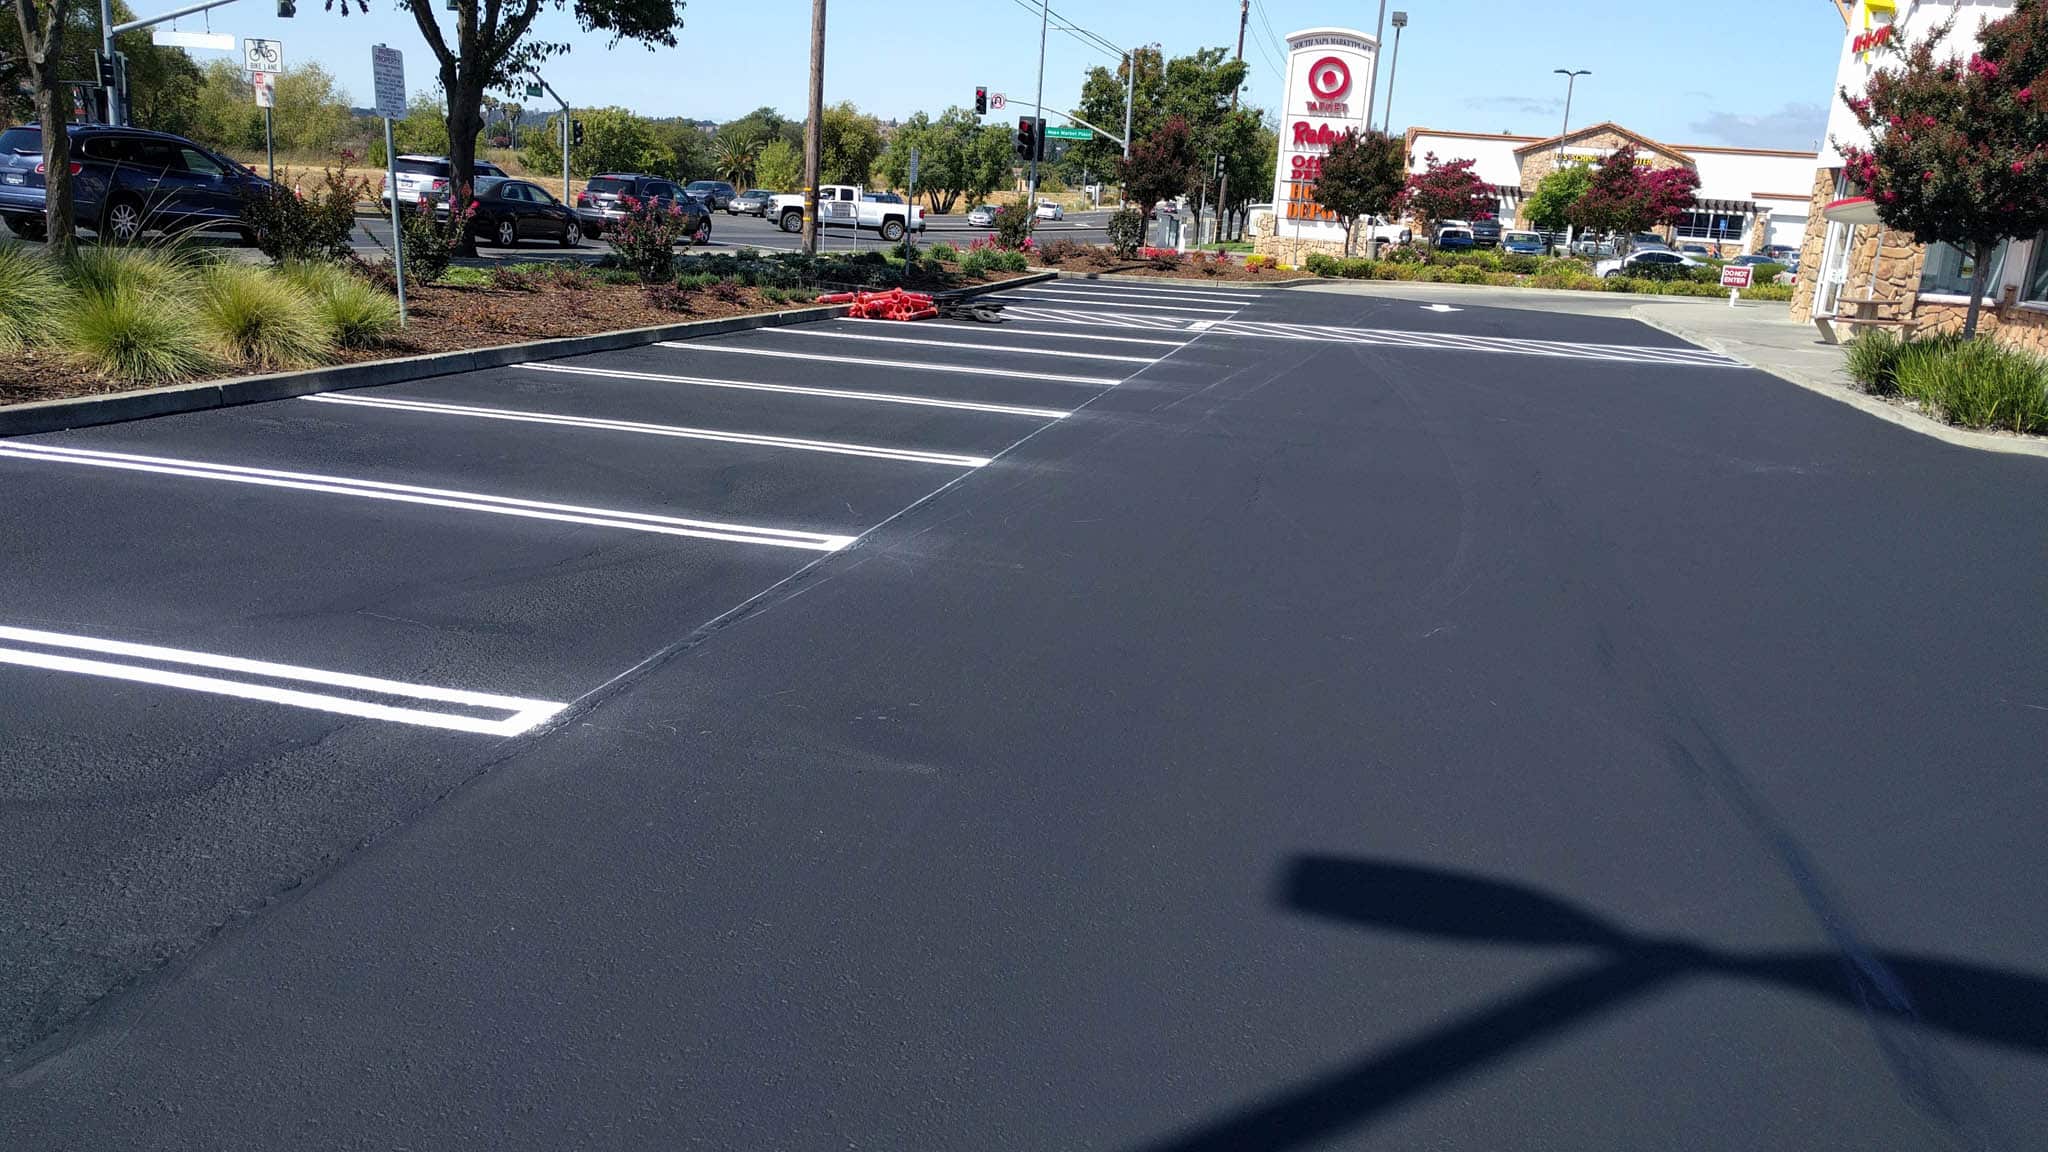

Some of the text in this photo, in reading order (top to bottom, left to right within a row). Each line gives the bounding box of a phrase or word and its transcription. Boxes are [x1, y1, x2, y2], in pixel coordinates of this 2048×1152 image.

[1293, 37, 1373, 52] SOUTH NAPA MARKETPLACE
[263, 63, 278, 71] LANE
[1306, 101, 1349, 114] TARGET
